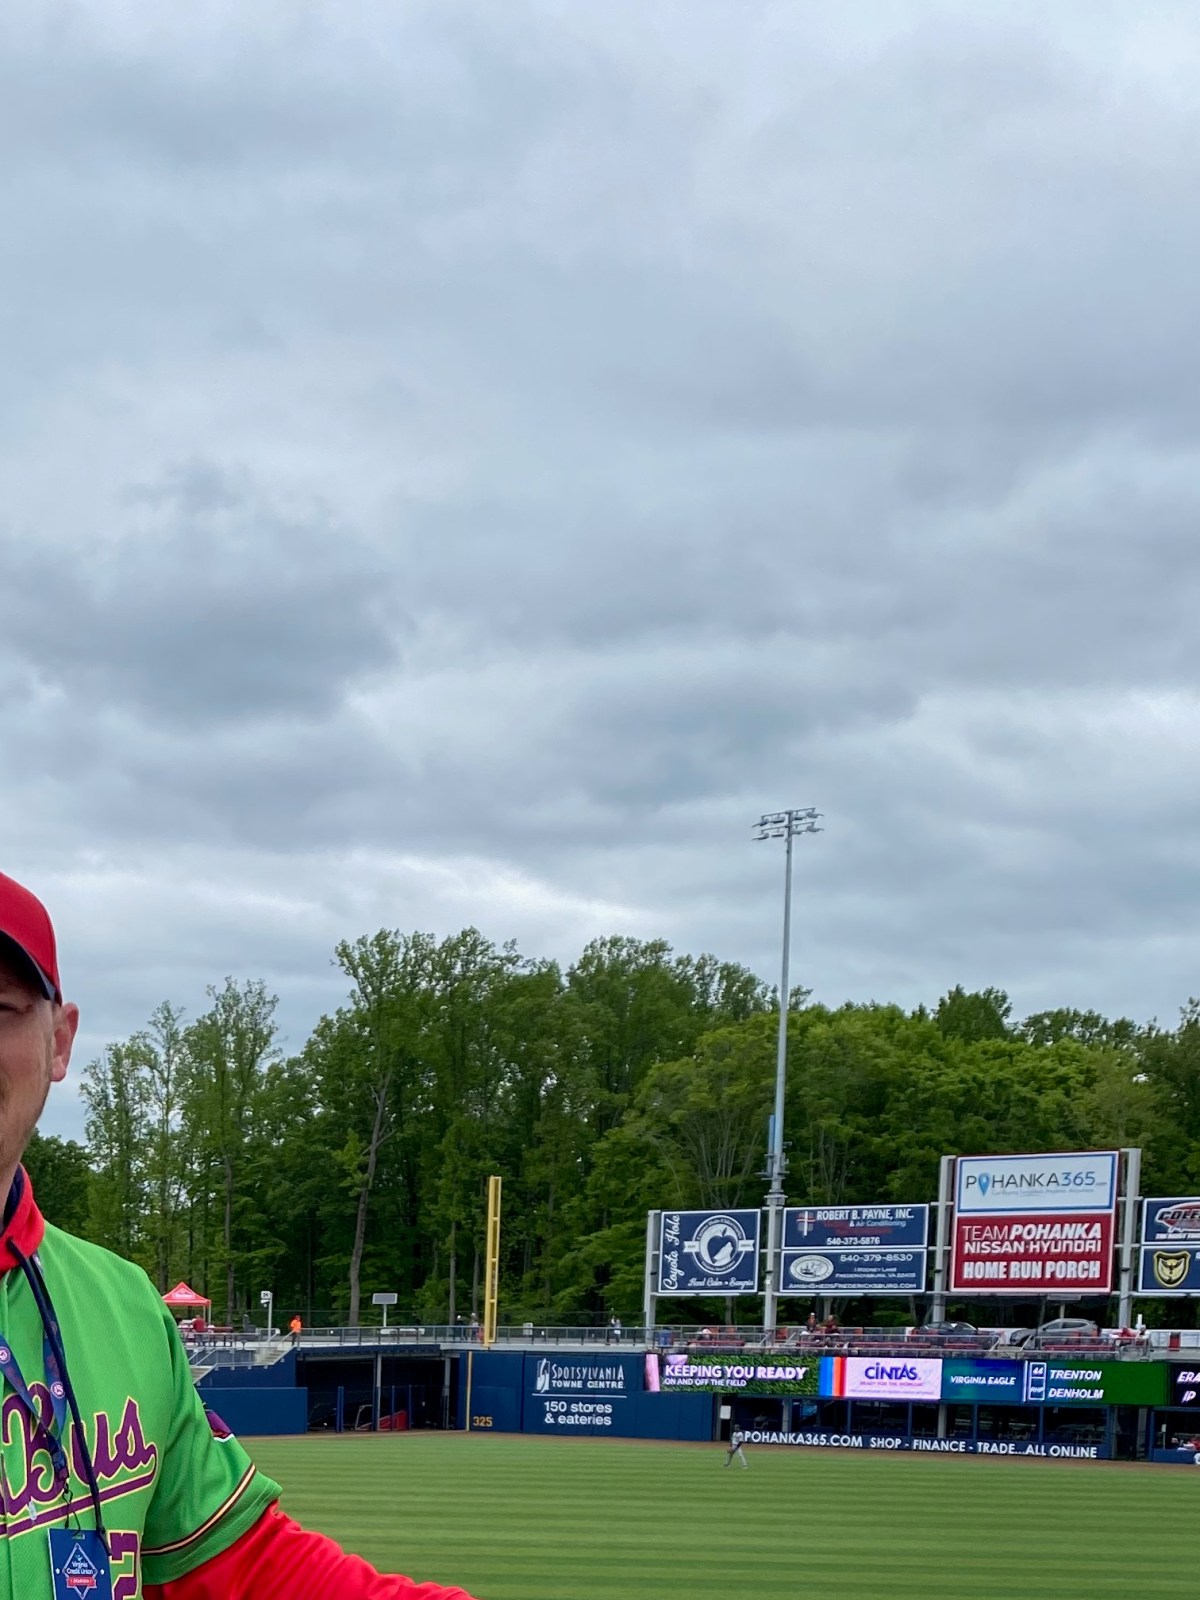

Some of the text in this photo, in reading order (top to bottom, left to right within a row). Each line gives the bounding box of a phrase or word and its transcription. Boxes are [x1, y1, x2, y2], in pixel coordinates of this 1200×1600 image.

[816, 1207, 915, 1221] ROBERT B. PAYNE, INC.
[963, 1223, 1101, 1241] TEAM POHANKA
[826, 1236, 881, 1246] 540-373-5876
[663, 1214, 685, 1290] Coyote Hole
[840, 1253, 913, 1262] 540-379-8530
[963, 1260, 1101, 1279] HOME RUN PORCH
[551, 1363, 625, 1380] SPOTSYLVANIA
[665, 1365, 807, 1380] KEEPING YOU READY
[1032, 1367, 1044, 1375] 44
[1050, 1370, 1103, 1380] TRENTON
[552, 1380, 624, 1389] TOWNE CENTRE
[710, 1379, 724, 1387] THE
[726, 1379, 747, 1387] FIELD
[950, 1375, 1016, 1386] VIRGINIA EAGLE
[1048, 1387, 1104, 1399] DENHOLM
[544, 1401, 612, 1414] 150 stores
[472, 1416, 493, 1427] 325
[544, 1412, 612, 1426] & eateries
[744, 1430, 863, 1448] POHANKA365.COM
[870, 1437, 902, 1449] SHOP
[913, 1439, 966, 1452] FINANCE
[1050, 1445, 1098, 1458] ONLINE
